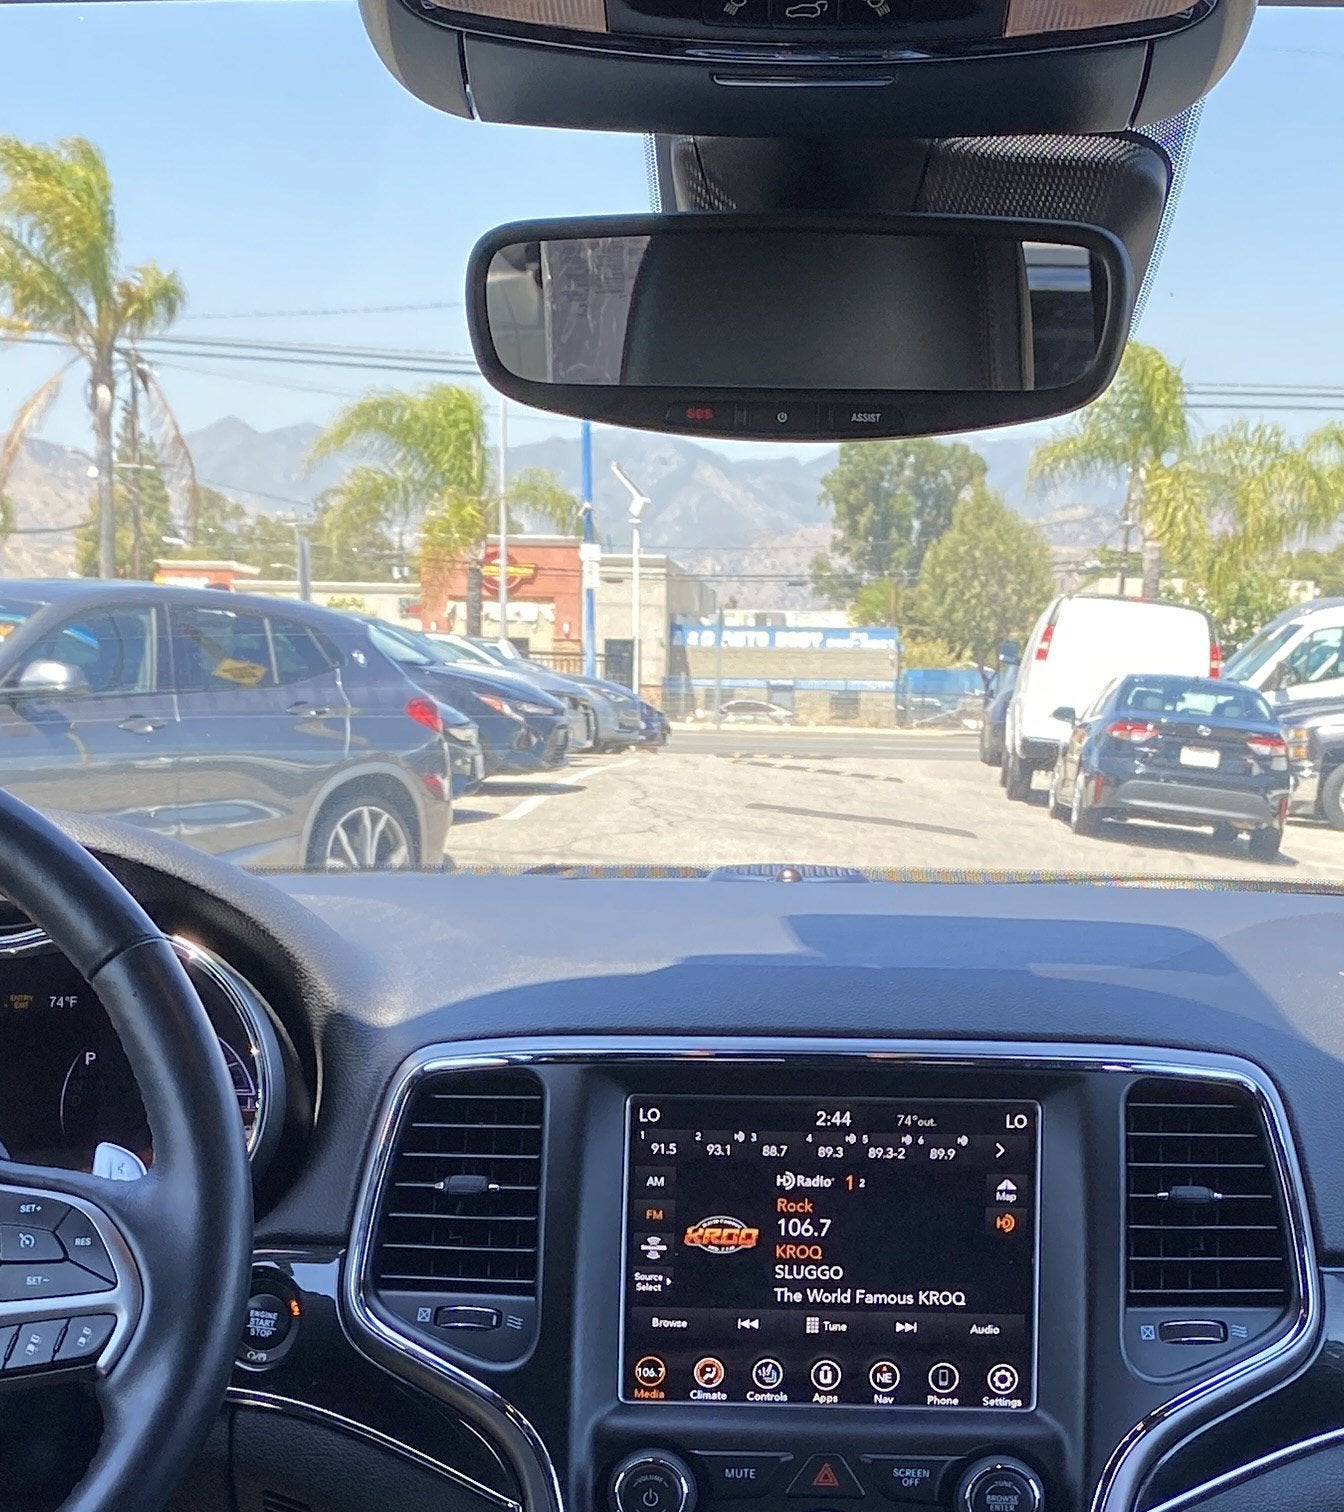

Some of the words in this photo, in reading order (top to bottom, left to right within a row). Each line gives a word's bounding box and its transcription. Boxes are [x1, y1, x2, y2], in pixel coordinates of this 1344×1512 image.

[686, 408, 714, 420] SOS
[851, 413, 881, 423] ASSIST
[721, 631, 770, 647] AUTO
[49, 996, 78, 1008] 74°F
[85, 1052, 96, 1066] P
[639, 1108, 661, 1122] LO
[816, 1111, 852, 1127] 2:44
[1006, 1114, 1027, 1129] LO
[695, 1131, 702, 1141] 2
[750, 1133, 757, 1142] 3
[806, 1134, 813, 1143] 4
[862, 1135, 869, 1144] 5
[917, 1135, 925, 1145] 6
[651, 1143, 677, 1155] 91.5
[707, 1144, 731, 1156] 93.1
[762, 1145, 788, 1157] 88.7
[818, 1146, 844, 1158] 89.3
[868, 1147, 906, 1159] 89.3-2
[929, 1148, 956, 1160] 89.9
[646, 1176, 665, 1187] AM
[797, 1174, 833, 1188] Radio
[846, 1175, 853, 1191] 1
[859, 1178, 865, 1188] 2
[995, 1192, 1017, 1203] Map
[20, 1204, 42, 1213] SET+
[776, 1198, 813, 1213] Rock
[646, 1209, 663, 1220] FM
[777, 1218, 832, 1237] 106.7
[75, 1238, 91, 1246] RES
[776, 1245, 823, 1260] KROQ
[634, 1272, 663, 1281] Source
[774, 1265, 843, 1280] SLUGGO
[636, 1283, 662, 1292] Select
[774, 1287, 802, 1303] The
[806, 1288, 851, 1304] World
[856, 1289, 914, 1305] Famous
[918, 1291, 966, 1306] KROQ
[249, 1309, 278, 1320] ENGINE
[249, 1318, 275, 1327] START
[651, 1317, 688, 1329] Browse
[823, 1321, 848, 1332] Tune
[250, 1329, 272, 1337] STOP
[970, 1324, 1000, 1335] Audio
[637, 1367, 664, 1378] 106.7
[876, 1373, 893, 1384] NE
[634, 1388, 665, 1399] Media
[689, 1390, 727, 1400] Climate
[746, 1391, 788, 1402] Controls
[812, 1395, 839, 1405] Apps
[874, 1395, 895, 1404] Nav
[927, 1396, 959, 1406] Phone
[982, 1396, 1023, 1409] Settings
[725, 1468, 756, 1480] MUTE
[893, 1468, 930, 1478] SCREEN
[638, 1475, 664, 1484] VOLUME
[902, 1478, 921, 1487] OFF
[986, 1494, 1019, 1502] BROWSE
[989, 1504, 1015, 1512] ENTER
